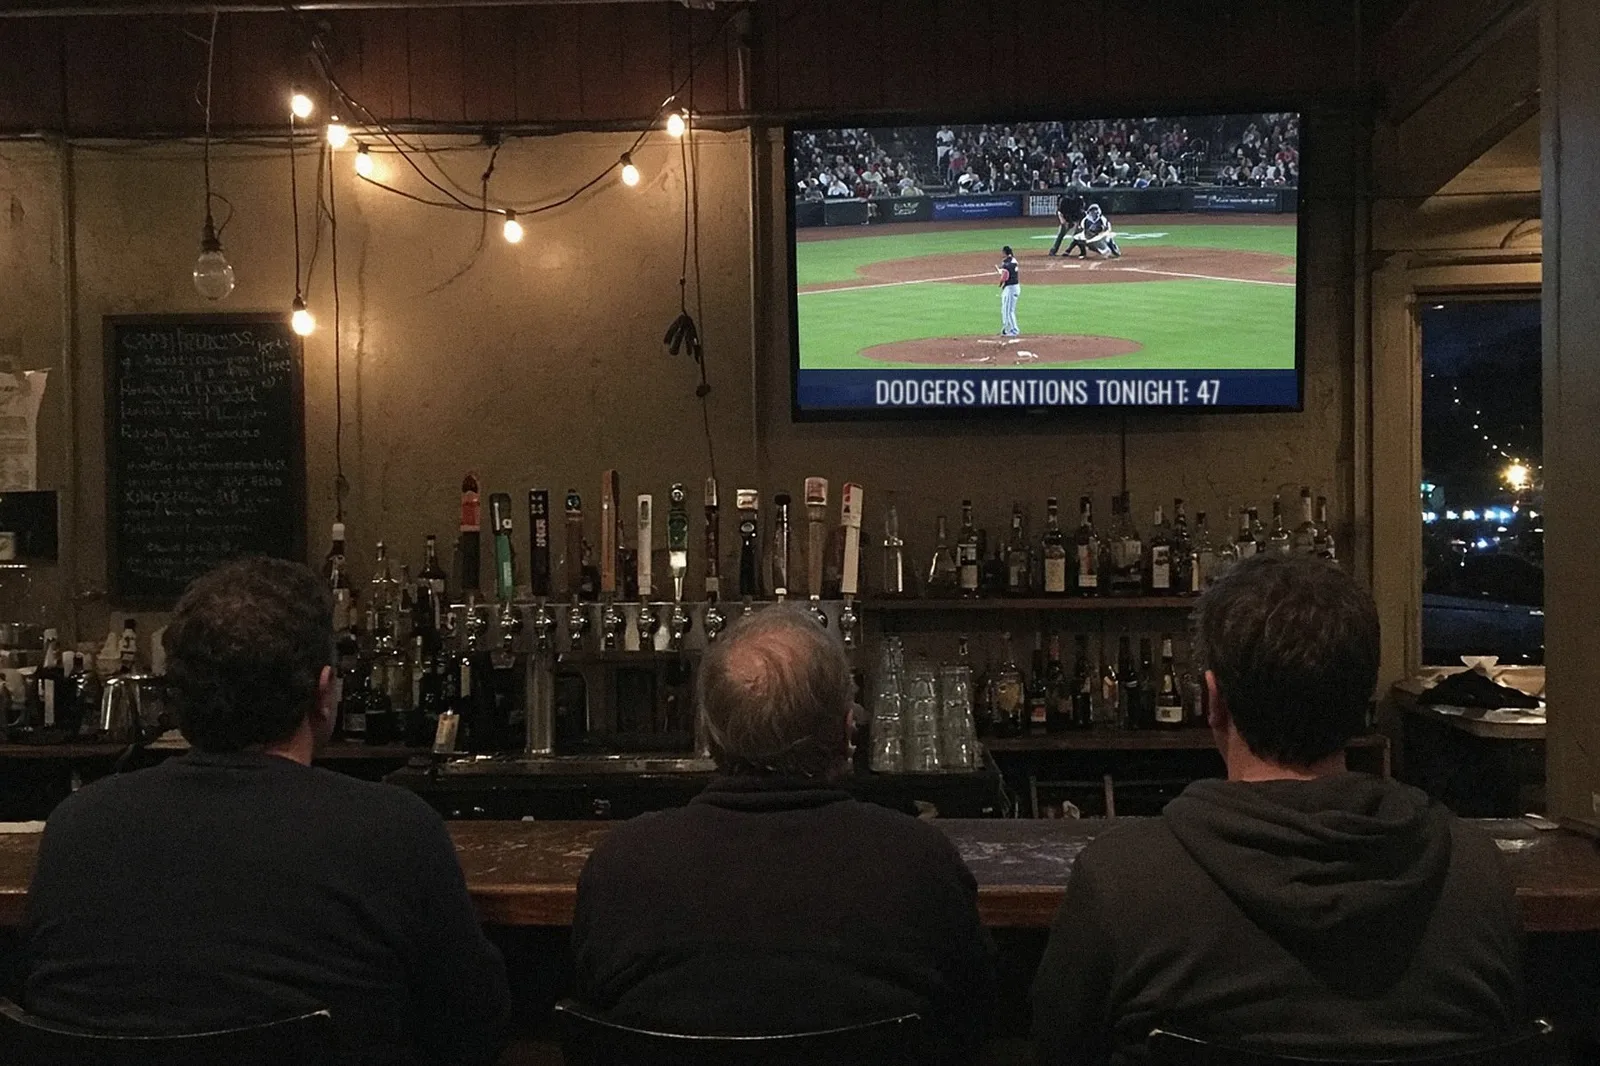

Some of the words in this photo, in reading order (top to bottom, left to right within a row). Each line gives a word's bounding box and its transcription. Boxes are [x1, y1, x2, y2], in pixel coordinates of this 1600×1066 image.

[876, 379, 975, 405] DODGERS
[981, 379, 1088, 405] MENTIONS
[1096, 379, 1189, 405] TONIGHT:
[1196, 380, 1221, 405] 47
